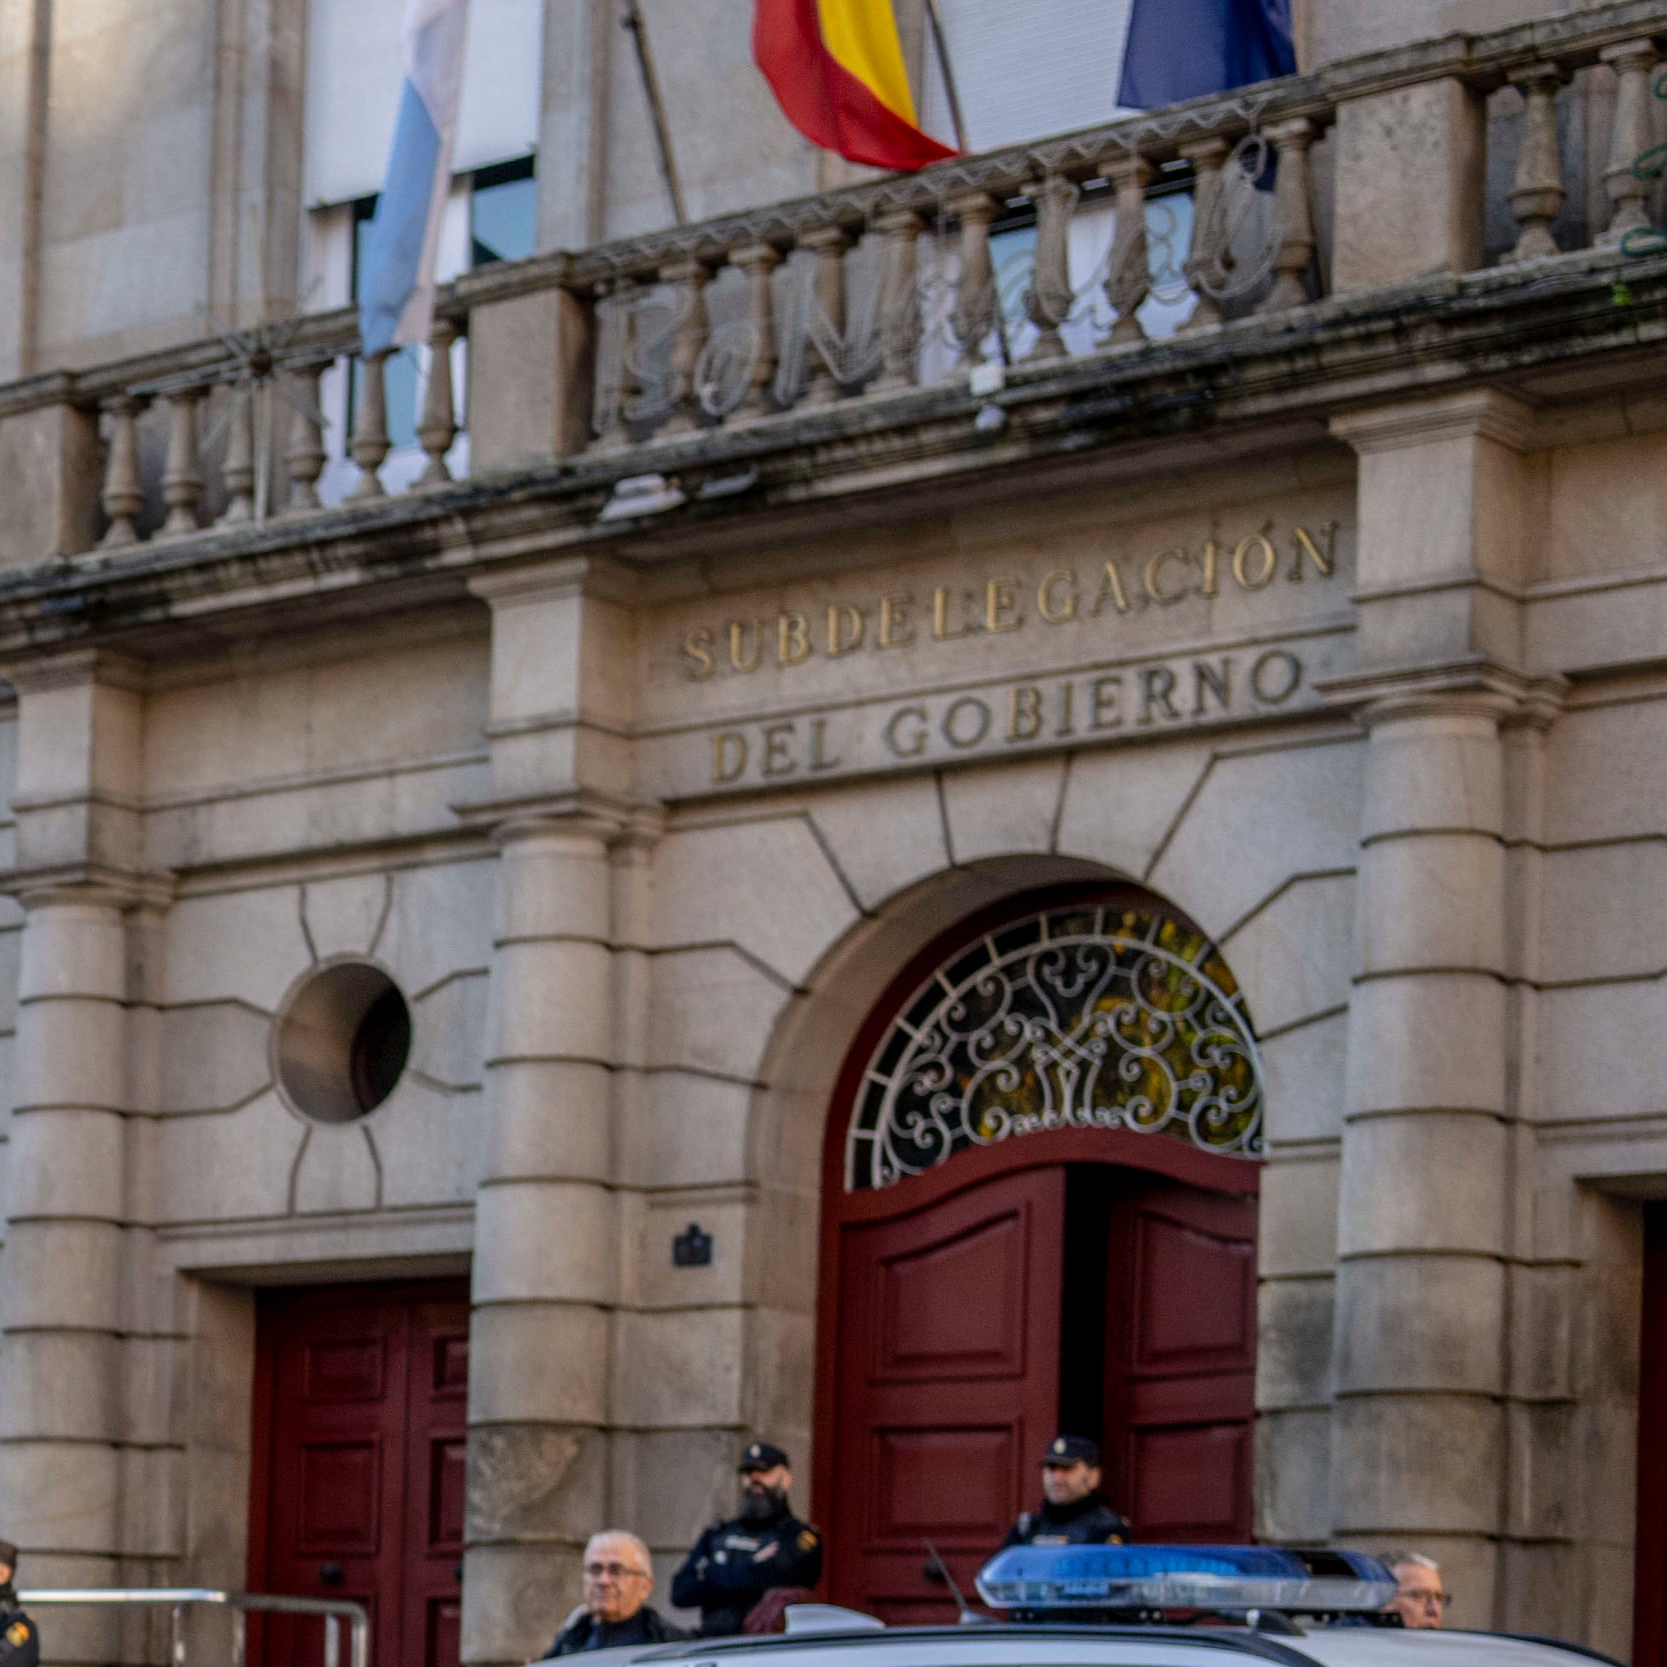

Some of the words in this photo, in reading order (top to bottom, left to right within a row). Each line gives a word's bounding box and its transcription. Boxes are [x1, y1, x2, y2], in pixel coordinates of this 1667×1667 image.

[681, 519, 1339, 683] SUBDELEGACIÓN
[710, 718, 841, 786] DEL
[882, 650, 1303, 760] GOBIERNO
